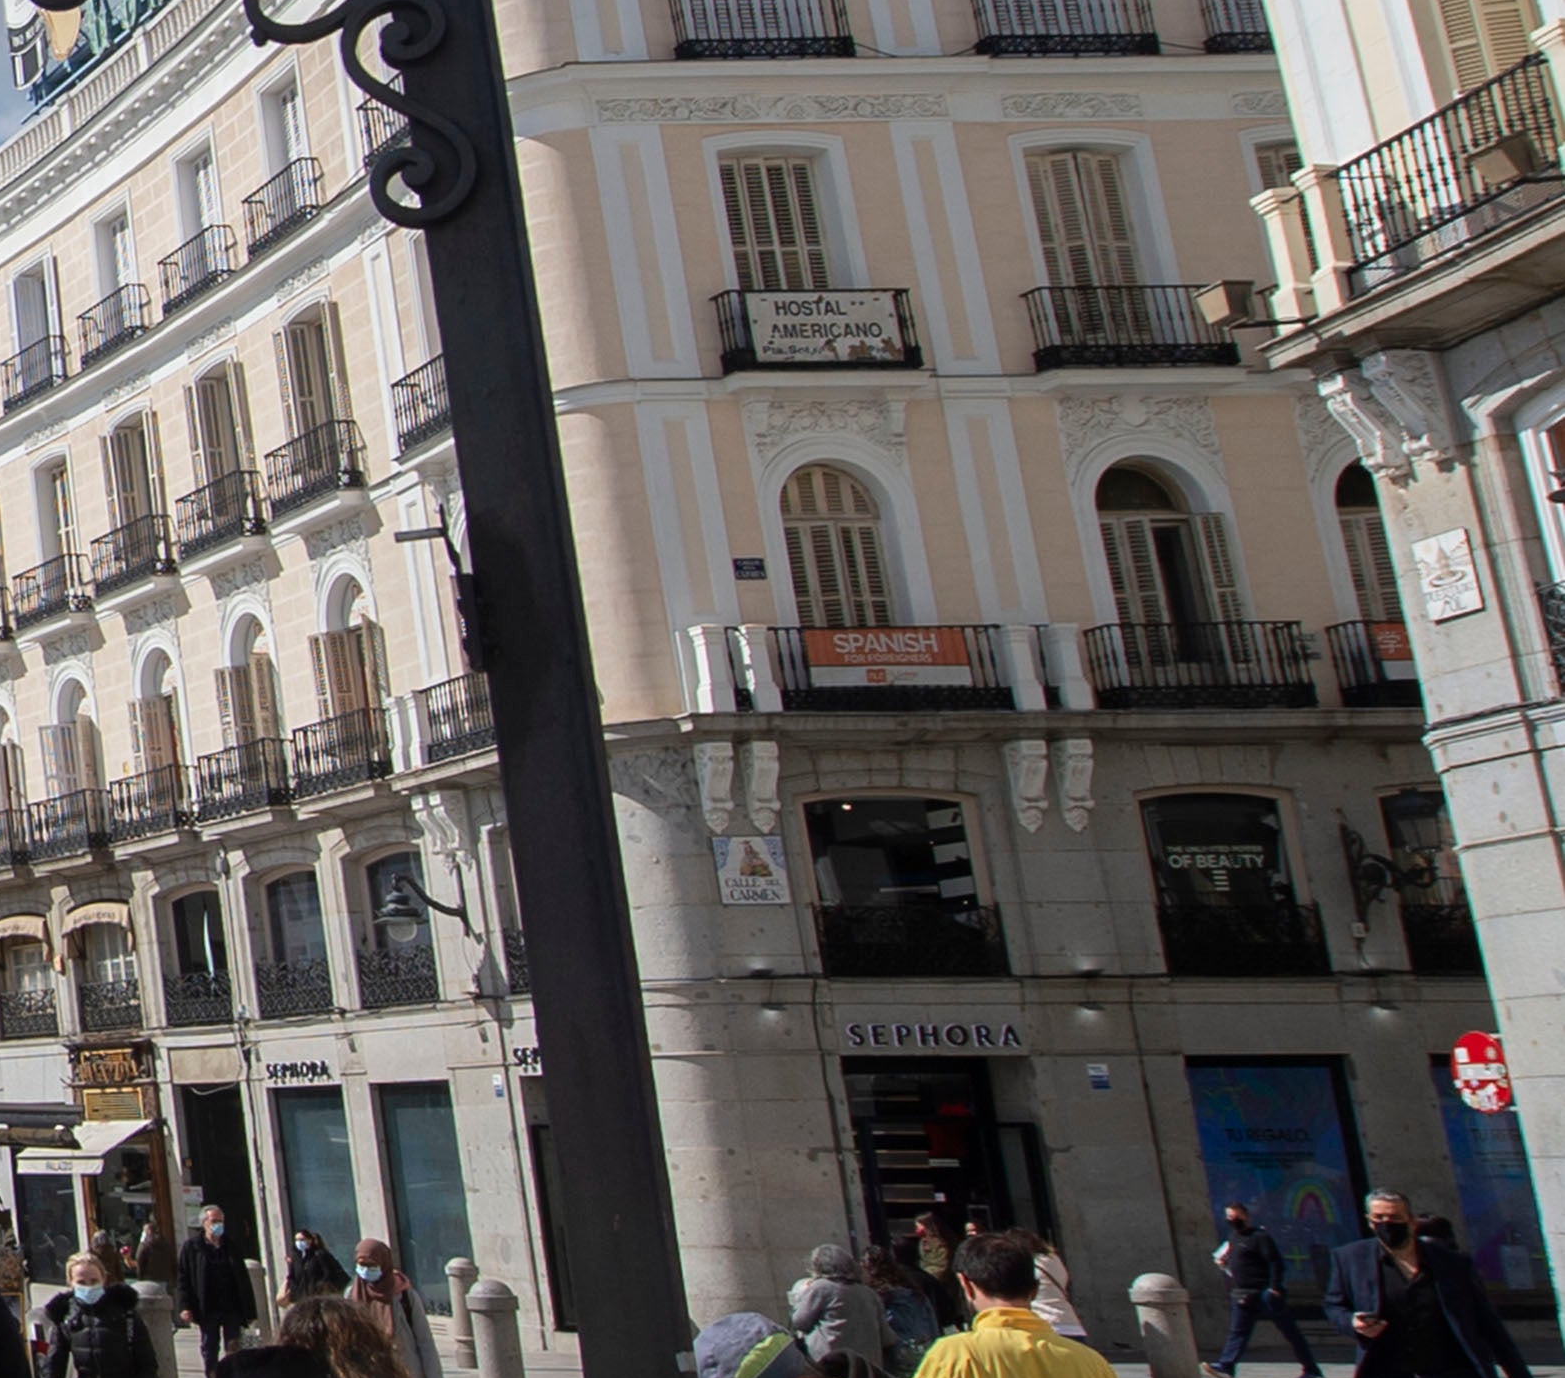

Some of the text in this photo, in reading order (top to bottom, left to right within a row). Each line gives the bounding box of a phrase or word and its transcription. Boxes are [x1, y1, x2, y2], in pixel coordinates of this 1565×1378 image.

[775, 300, 847, 316] HOSTAL
[772, 322, 882, 339] AMERICANO
[833, 633, 938, 653] SPANISH
[844, 653, 932, 664] FOR FOREIGNERS
[1168, 853, 1264, 869] OF BEAUTY
[725, 878, 760, 888] CALLE
[730, 888, 781, 902] CARMEN
[845, 1023, 1021, 1047] SEPHORA
